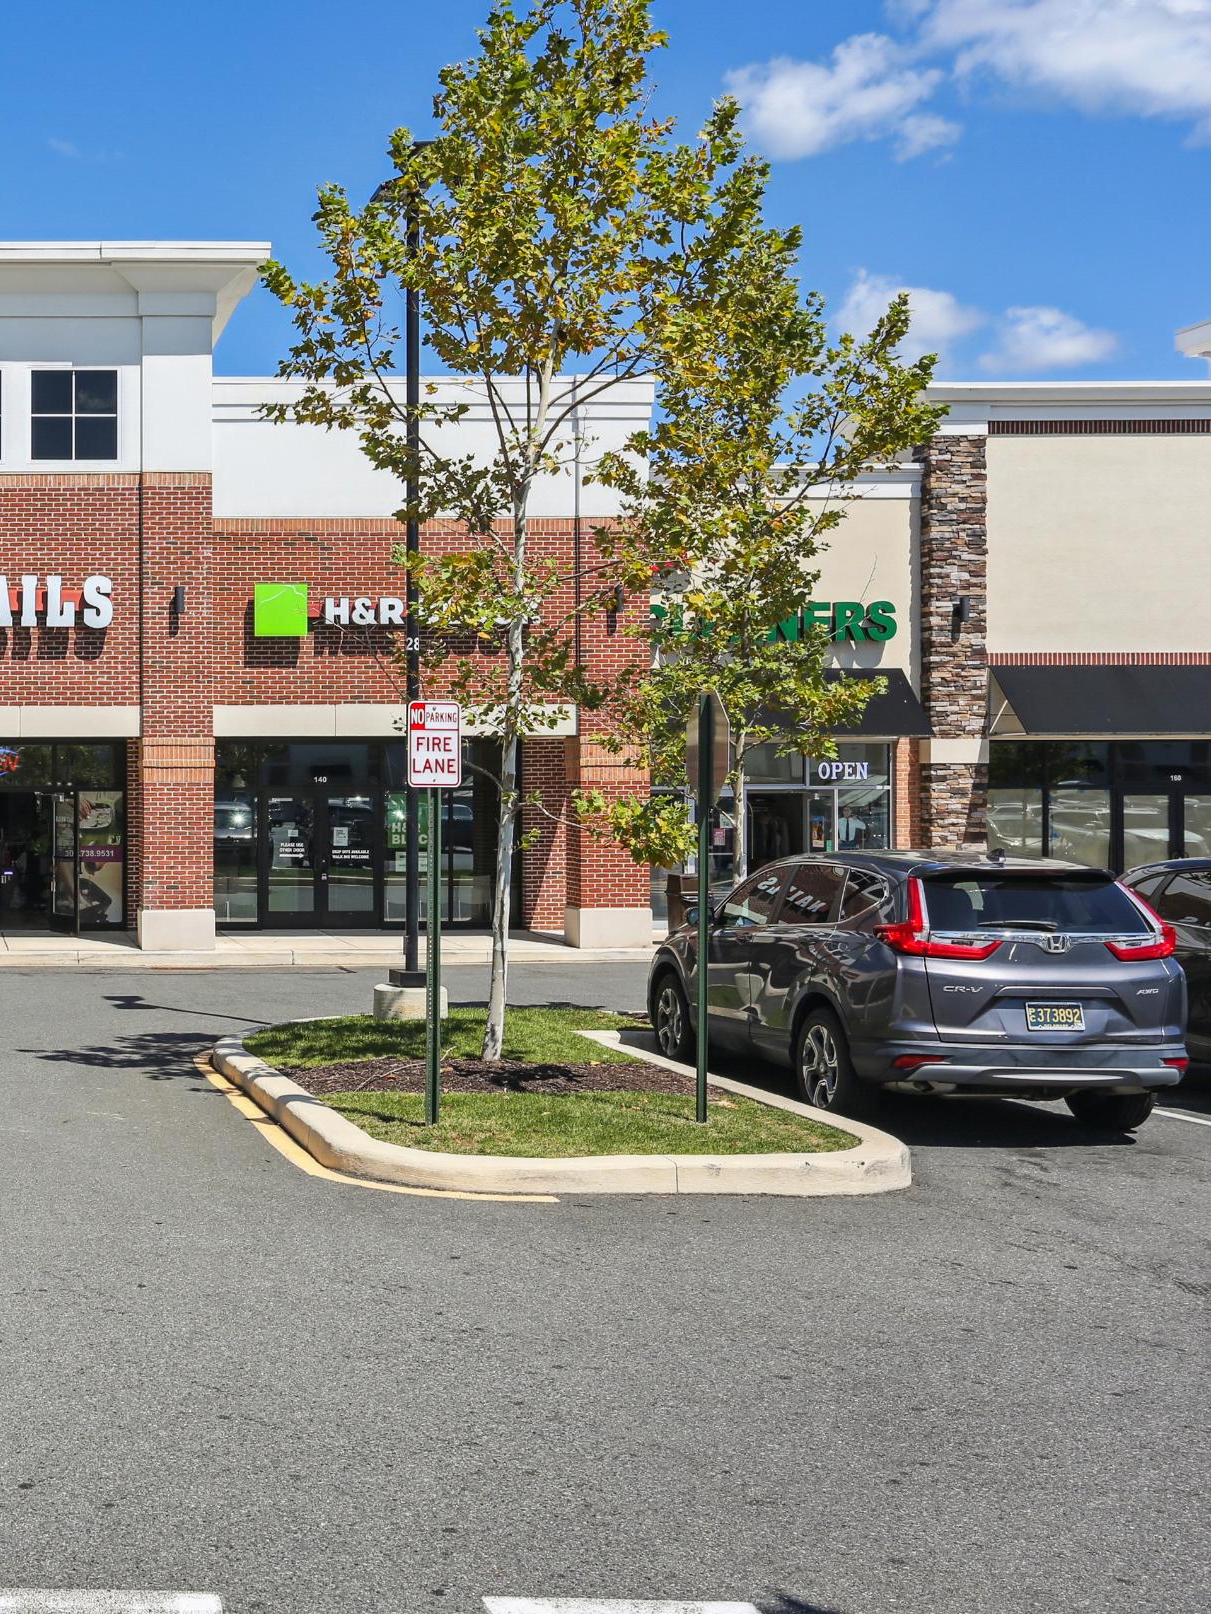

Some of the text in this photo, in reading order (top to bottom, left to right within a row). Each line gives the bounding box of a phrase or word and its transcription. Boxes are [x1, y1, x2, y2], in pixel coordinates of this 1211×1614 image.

[325, 597, 404, 625] H&R
[406, 637, 420, 651] 28
[411, 709, 457, 724] NO PARKING
[416, 737, 452, 752] FIRE
[413, 758, 456, 774] LANE
[817, 762, 869, 780] OPEN
[64, 849, 114, 857] 30.738.9531
[943, 985, 983, 993] CR-V
[1136, 988, 1159, 996] AWD
[1037, 1008, 1081, 1023] 373892
